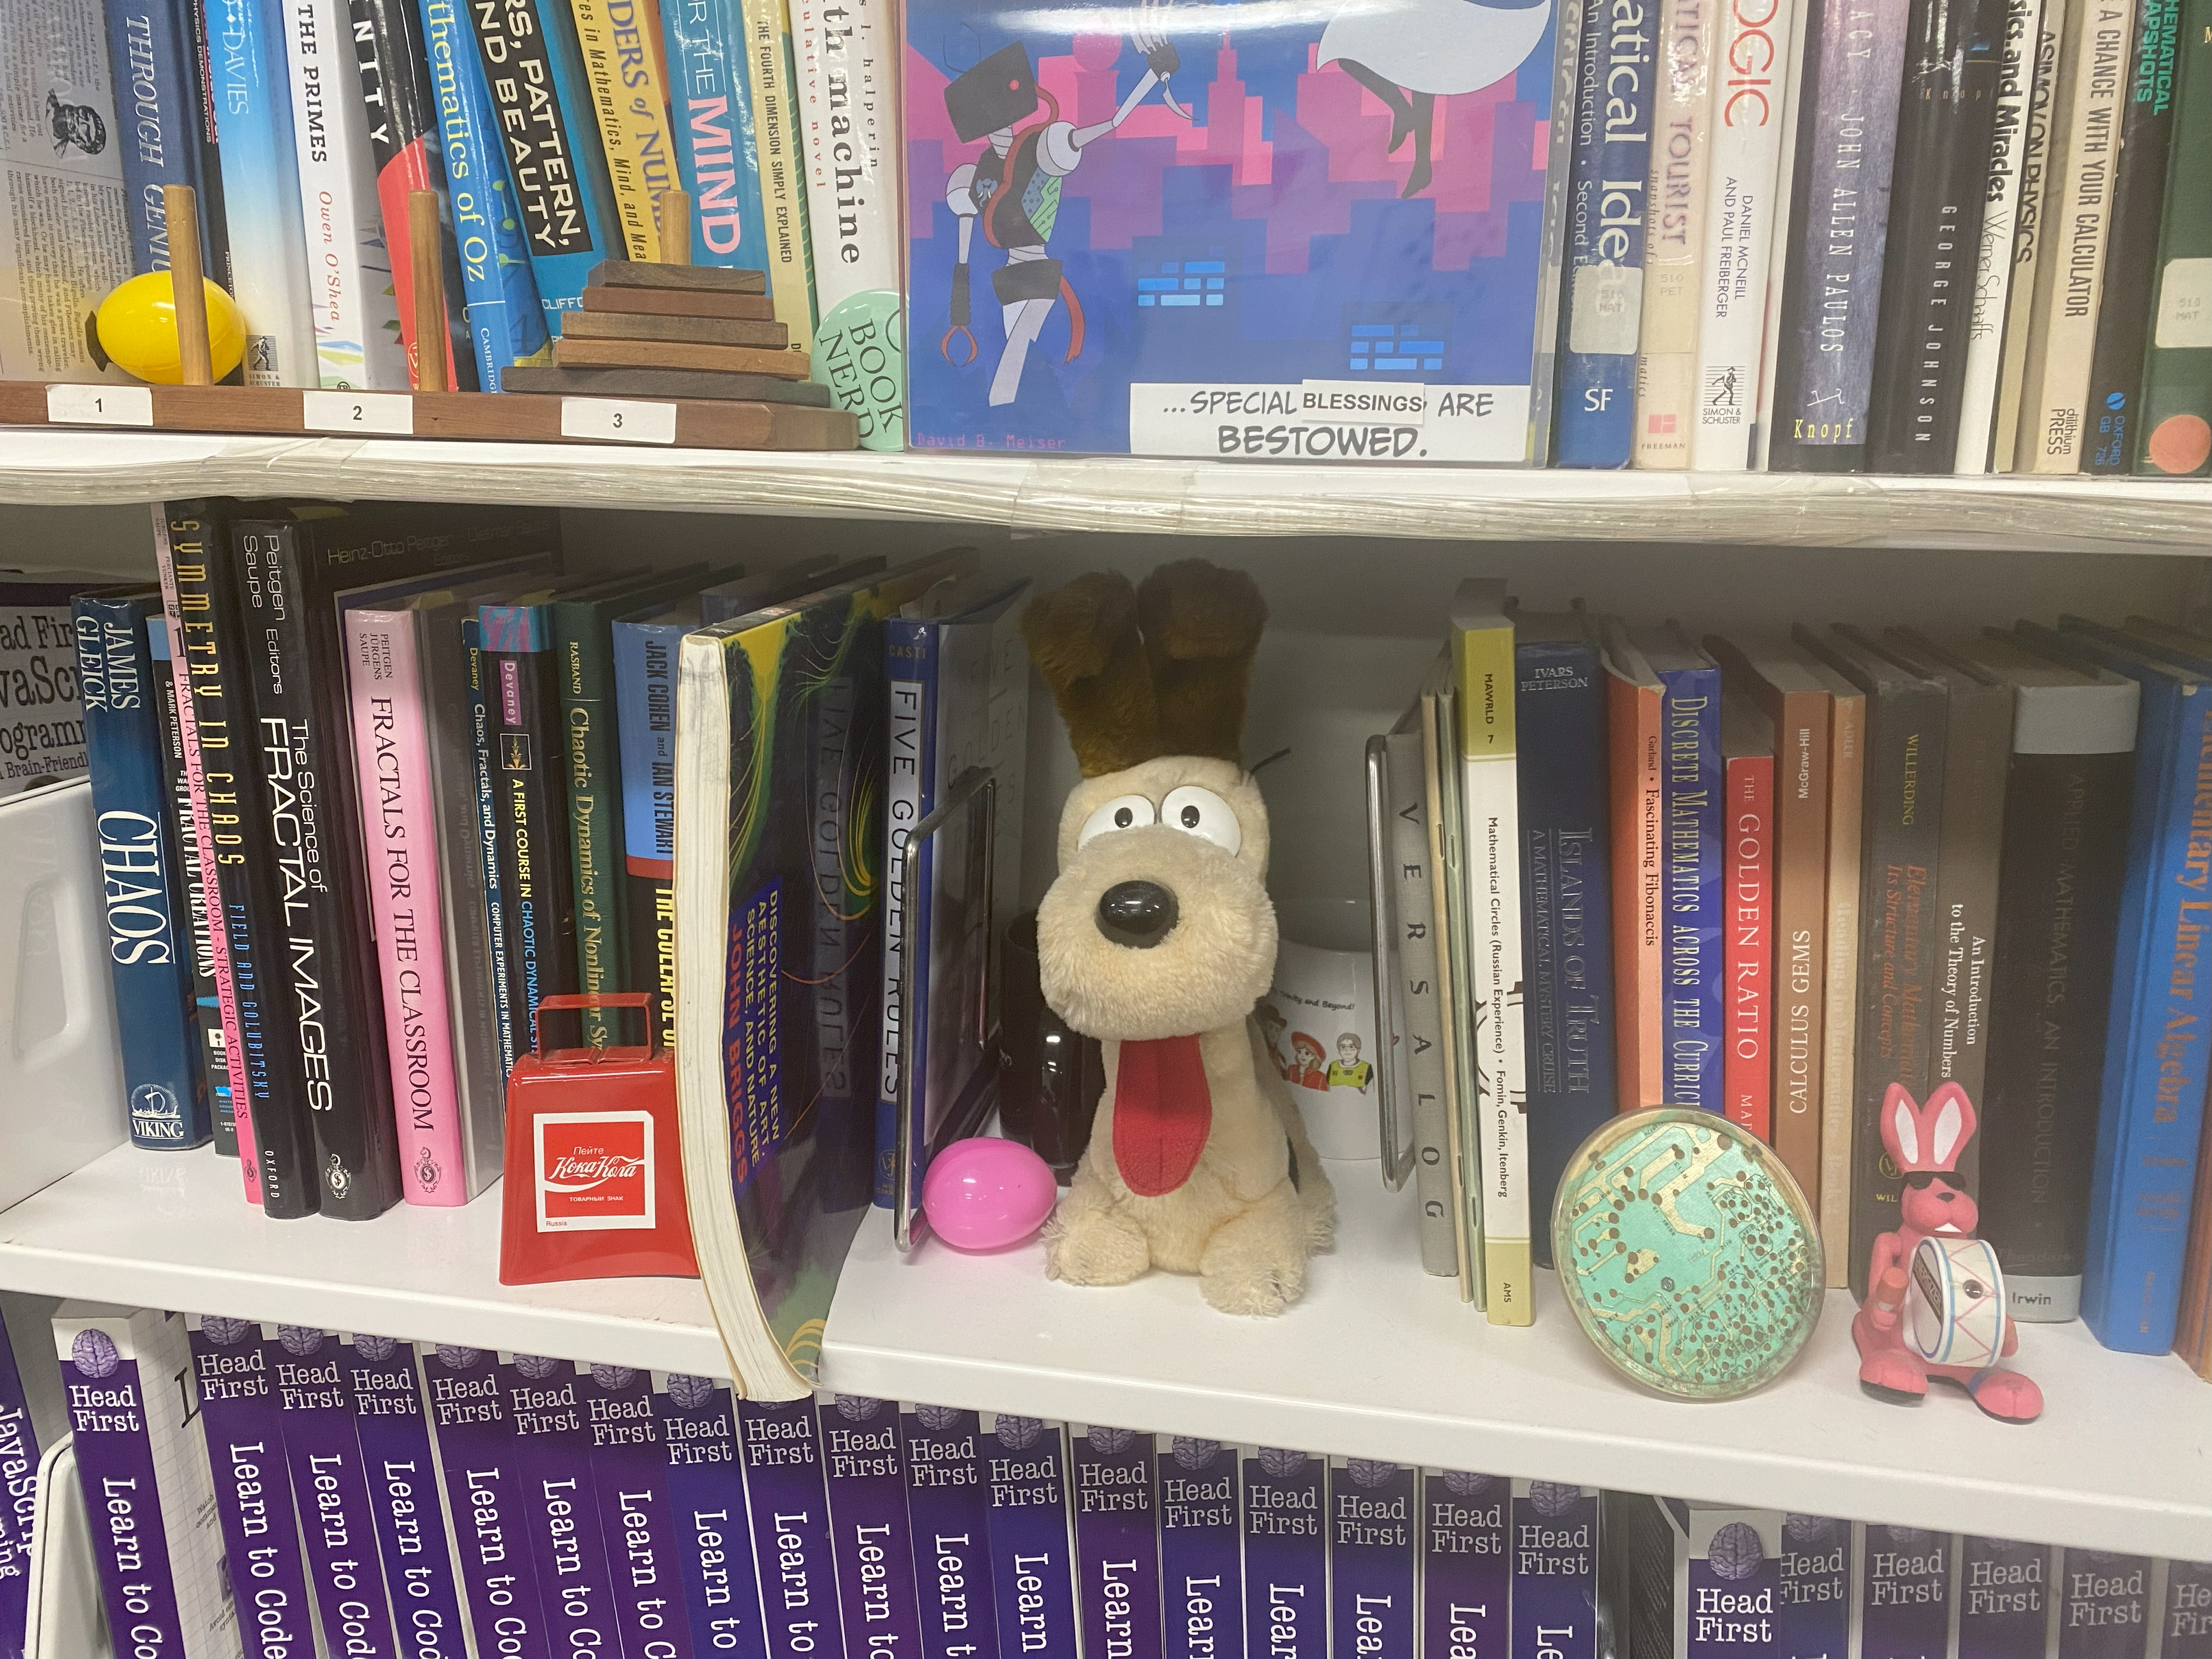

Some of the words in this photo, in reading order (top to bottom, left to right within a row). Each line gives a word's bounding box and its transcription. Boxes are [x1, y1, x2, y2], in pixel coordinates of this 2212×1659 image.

[298, 4, 315, 55] THE
[584, 28, 598, 42] in
[2099, 9, 2123, 22] A
[222, 31, 249, 114] DAVIES
[759, 46, 774, 89] FOURTH
[1581, 32, 1601, 146] Introduction
[2090, 29, 2121, 99] CHANGE
[126, 15, 164, 167] THROUGH
[304, 66, 328, 162] PRIMES
[426, 0, 471, 180] thematics
[589, 48, 622, 151] Mathematics,
[765, 95, 781, 155] DIMENSION
[1836, 115, 1864, 169] JOHN
[2084, 107, 2112, 153] WITH
[494, 78, 556, 247] BEAUTY
[518, 59, 581, 246] PATTERN,
[613, 158, 635, 196] Mind,
[689, 95, 740, 254] MIND
[828, 74, 865, 264] machine
[8, 170, 19, 202] through
[771, 161, 786, 200] SIMPLY
[1663, 117, 1692, 245] TOURIST
[1725, 177, 1736, 206] AND
[2078, 159, 2106, 207] YOUR
[12, 205, 21, 216] his
[12, 219, 23, 241] many
[319, 191, 334, 245] Owen
[457, 192, 484, 226] of
[623, 203, 643, 228] and
[775, 206, 792, 263] EXPLAINED
[1577, 181, 1592, 246] Second
[1722, 212, 1735, 241] PAUL
[1740, 195, 1753, 241] DANIEL
[1830, 188, 1858, 256] ALLEN
[15, 243, 28, 285] significant
[464, 236, 489, 281] Oz
[1716, 245, 1732, 318] FREIBERGER
[1735, 245, 1750, 300] MCNEILL
[1931, 206, 1957, 306] GEORGE
[2065, 213, 2100, 317] CALCULATOR
[324, 252, 340, 321] O'Shea
[20, 287, 34, 356] accomplishments.
[1820, 273, 1849, 352] PAULOS
[819, 329, 874, 438] NERD
[849, 318, 904, 433] BOOK
[1584, 388, 1613, 411] SF
[1915, 325, 1943, 441] JOHNSON
[95, 398, 103, 413] 1
[353, 406, 362, 421] 2
[613, 414, 623, 428] 3
[1302, 394, 1423, 413] BLESSINGS
[1438, 392, 1494, 417] ARE
[1703, 408, 1733, 416] SIMON
[919, 433, 965, 449] David
[976, 433, 991, 449] B.
[1006, 434, 1065, 449] Meiser
[1218, 426, 1428, 457] BESTOWED.
[1795, 418, 1853, 443] Knopf
[2047, 409, 2066, 455] PRESS
[2063, 408, 2079, 454] dilithium
[244, 536, 262, 608] Saupe
[264, 535, 285, 620] Peitgen
[171, 521, 222, 698] SYMMETRY
[76, 615, 108, 712] GLEICK
[104, 622, 140, 709] JAMES
[267, 629, 282, 694] Editors
[359, 633, 369, 666] SAUPE
[381, 634, 393, 678] PEITGEN
[469, 647, 479, 691] Devaney
[569, 642, 581, 694] RASBAND
[1534, 667, 1573, 678] IVARS
[505, 663, 516, 724] Devaney
[1484, 673, 1493, 725] MAWRLD
[1521, 678, 1588, 691] PETERSON
[199, 721, 229, 749] IN
[291, 719, 307, 765] The
[474, 704, 485, 746] Chaos,
[570, 707, 591, 788] Chaotic
[894, 691, 917, 775] FIVE
[1487, 735, 1493, 743] 7
[1671, 697, 1707, 783] DISCRETE
[371, 697, 405, 839] FRACTALS
[478, 749, 492, 801] Fractals,
[1648, 736, 1657, 771] Garland
[1798, 729, 1809, 799] McGraw-Hill
[513, 779, 523, 787] A
[1744, 775, 1754, 802] THE
[1903, 734, 1919, 825] WILLERDING
[206, 771, 245, 865] CHAOS
[298, 771, 320, 864] Science
[482, 804, 494, 826] and
[514, 791, 526, 826] FIRST
[1644, 789, 1660, 868] Fascinating
[486, 826, 500, 890] Dynamics
[516, 828, 531, 879] COURSE
[573, 794, 598, 895] Dynamics
[1488, 817, 1500, 893] Mathematical
[1672, 791, 1707, 912] MATHEMATICS
[98, 810, 171, 965] CHAOS
[309, 868, 328, 893] of
[386, 848, 410, 900] FOR
[520, 882, 532, 898] IN
[1738, 814, 1760, 947] GOLDEN
[229, 904, 249, 952] FIELD
[261, 717, 308, 927] FRACTAL
[289, 936, 332, 1111] IMAGES
[521, 901, 535, 957] CHAOTIC
[582, 899, 601, 924] of
[1491, 898, 1500, 937] Circles
[1645, 873, 1659, 946] Fibonaccis
[1950, 921, 1965, 944] the
[1951, 904, 1963, 917] to
[394, 909, 417, 962] THE
[1673, 926, 1700, 986] ACROSS
[1972, 936, 1985, 956] An
[237, 961, 255, 991] AND
[729, 926, 742, 1029] JOHN
[1489, 940, 1502, 986] (Russian
[1792, 930, 1810, 993] GEMS
[1942, 947, 1963, 995] Theory
[1398, 803, 1444, 1218] VERSALOG
[1493, 990, 1504, 1054] Experience)
[1674, 998, 1700, 1028] THE
[1737, 961, 1759, 1059] RATIO
[1945, 1000, 1960, 1015] of
[1966, 958, 1984, 1045] Introduction
[216, 946, 236, 1031] STRATEGIC
[227, 1034, 248, 1118] ACTIVITIES
[242, 1001, 269, 1098] GOLUBITSKY
[400, 970, 434, 1131] CLASSROOM
[1942, 1018, 1959, 1078] Numbers
[1790, 1005, 1809, 1114] CALCULUS
[728, 1040, 747, 1183] BRIGGS
[1496, 1071, 1506, 1108] Fomin,
[132, 1121, 184, 1138] VIKING
[573, 1146, 603, 1155] Пейте
[1497, 1110, 1508, 1150] Genkin,
[265, 1150, 280, 1198] OXFORD
[1498, 1154, 1509, 1198] Itenberg
[1502, 1282, 1511, 1303] AMS
[2012, 1293, 2052, 1305] Irwin
[197, 1350, 266, 1376] Head
[203, 1375, 268, 1400] First
[70, 1385, 136, 1407] Head
[76, 1410, 139, 1432] First
[663, 1415, 730, 1441] Head
[668, 1440, 732, 1465] First
[230, 1442, 268, 1537] Learn
[989, 1456, 1056, 1481] Head
[991, 1482, 1058, 1507] First
[103, 1477, 142, 1572] Learn
[123, 1583, 151, 1614] to
[248, 1547, 278, 1578] to
[693, 1509, 732, 1607] Learn
[1014, 1553, 1048, 1652] Learn
[1696, 1589, 1772, 1614] Head
[711, 1617, 740, 1647] to
[1696, 1617, 1772, 1642] First
